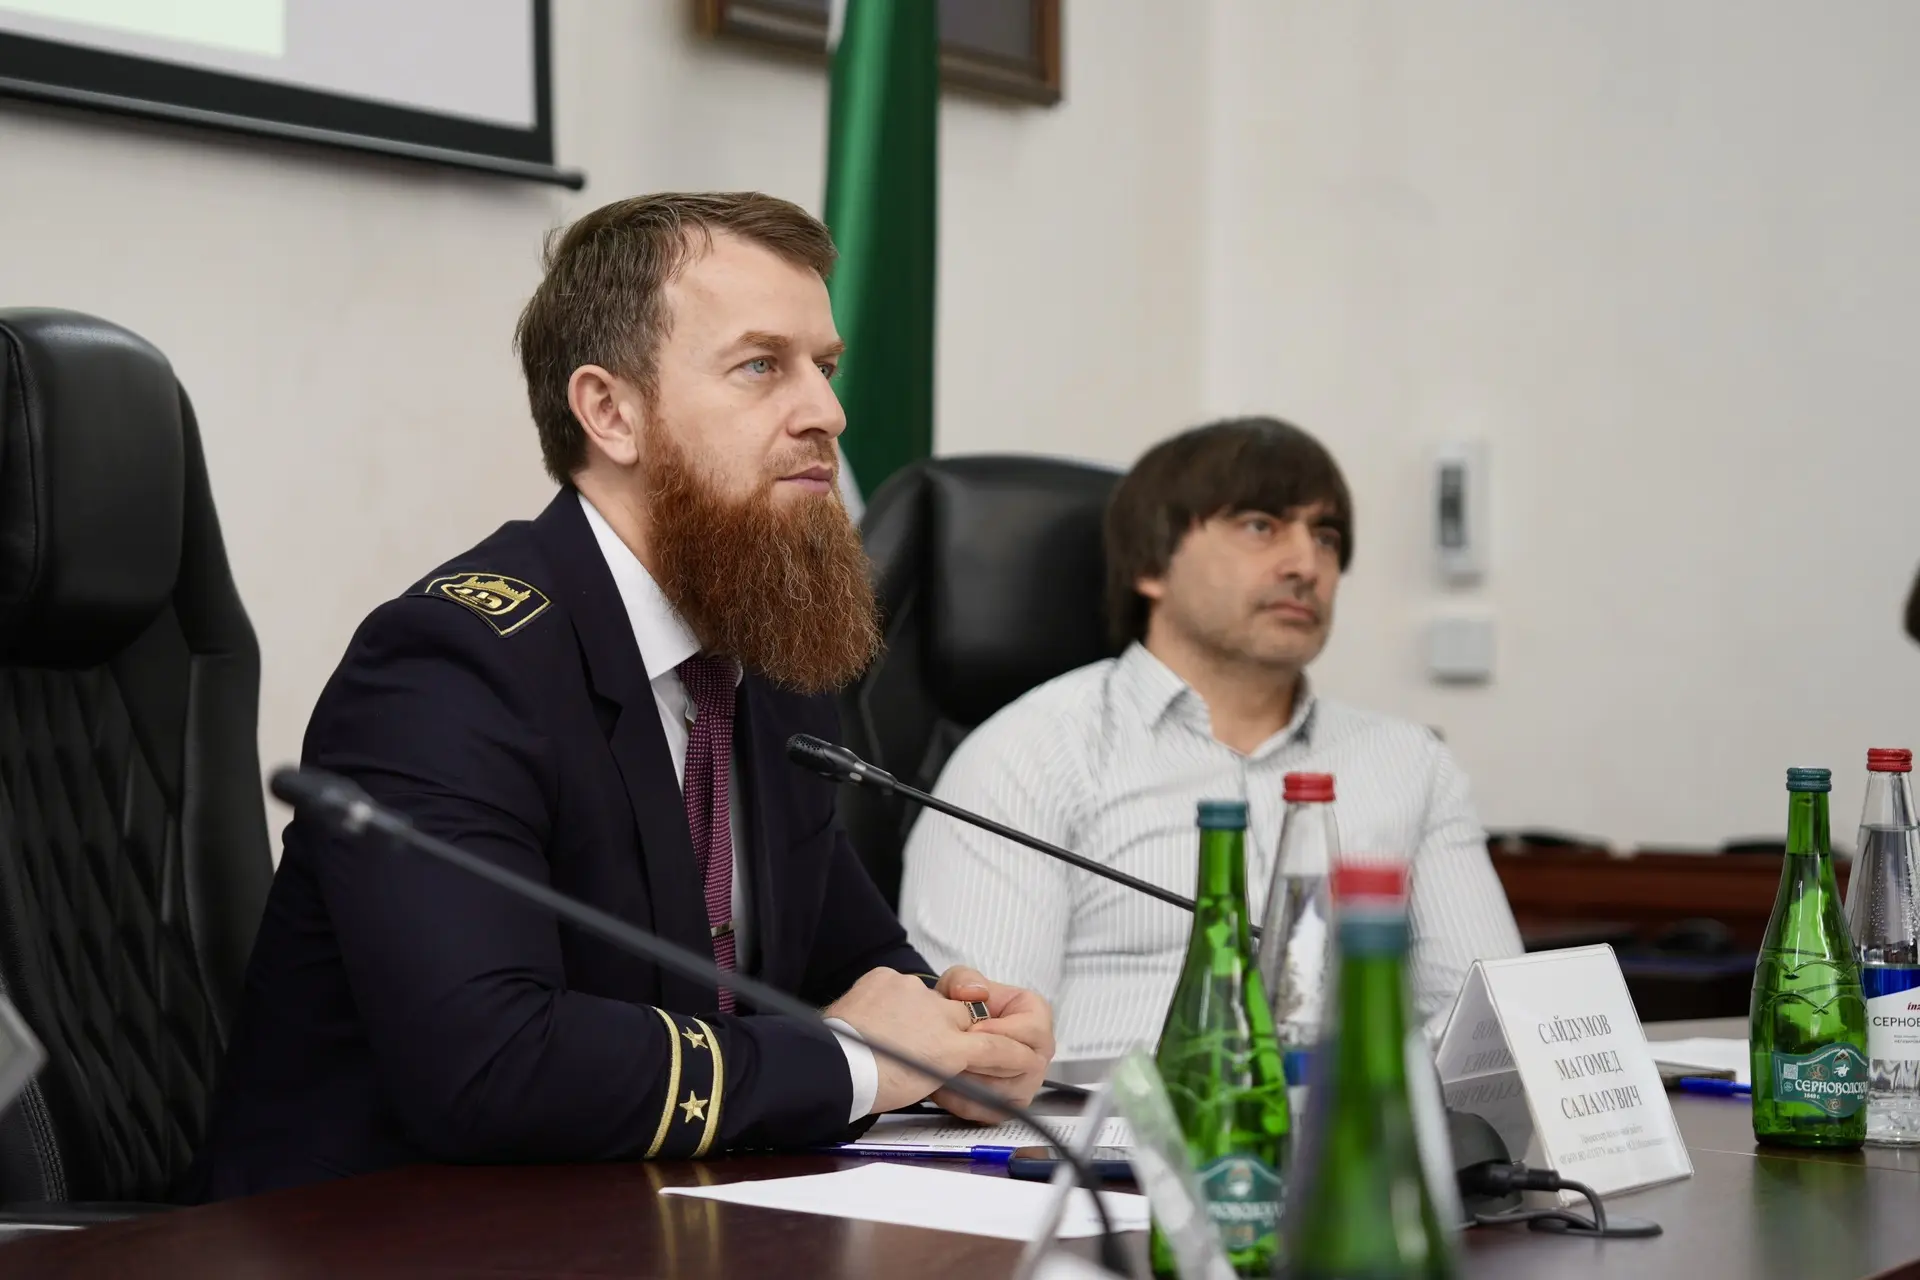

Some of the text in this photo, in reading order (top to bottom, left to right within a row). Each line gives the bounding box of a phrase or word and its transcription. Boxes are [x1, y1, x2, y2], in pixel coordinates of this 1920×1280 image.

[1538, 1015, 1612, 1045] САЙДУМОВ
[1555, 1050, 1624, 1081] МАГОМЕД
[1561, 1085, 1643, 1120] САЛАМУВИЧ
